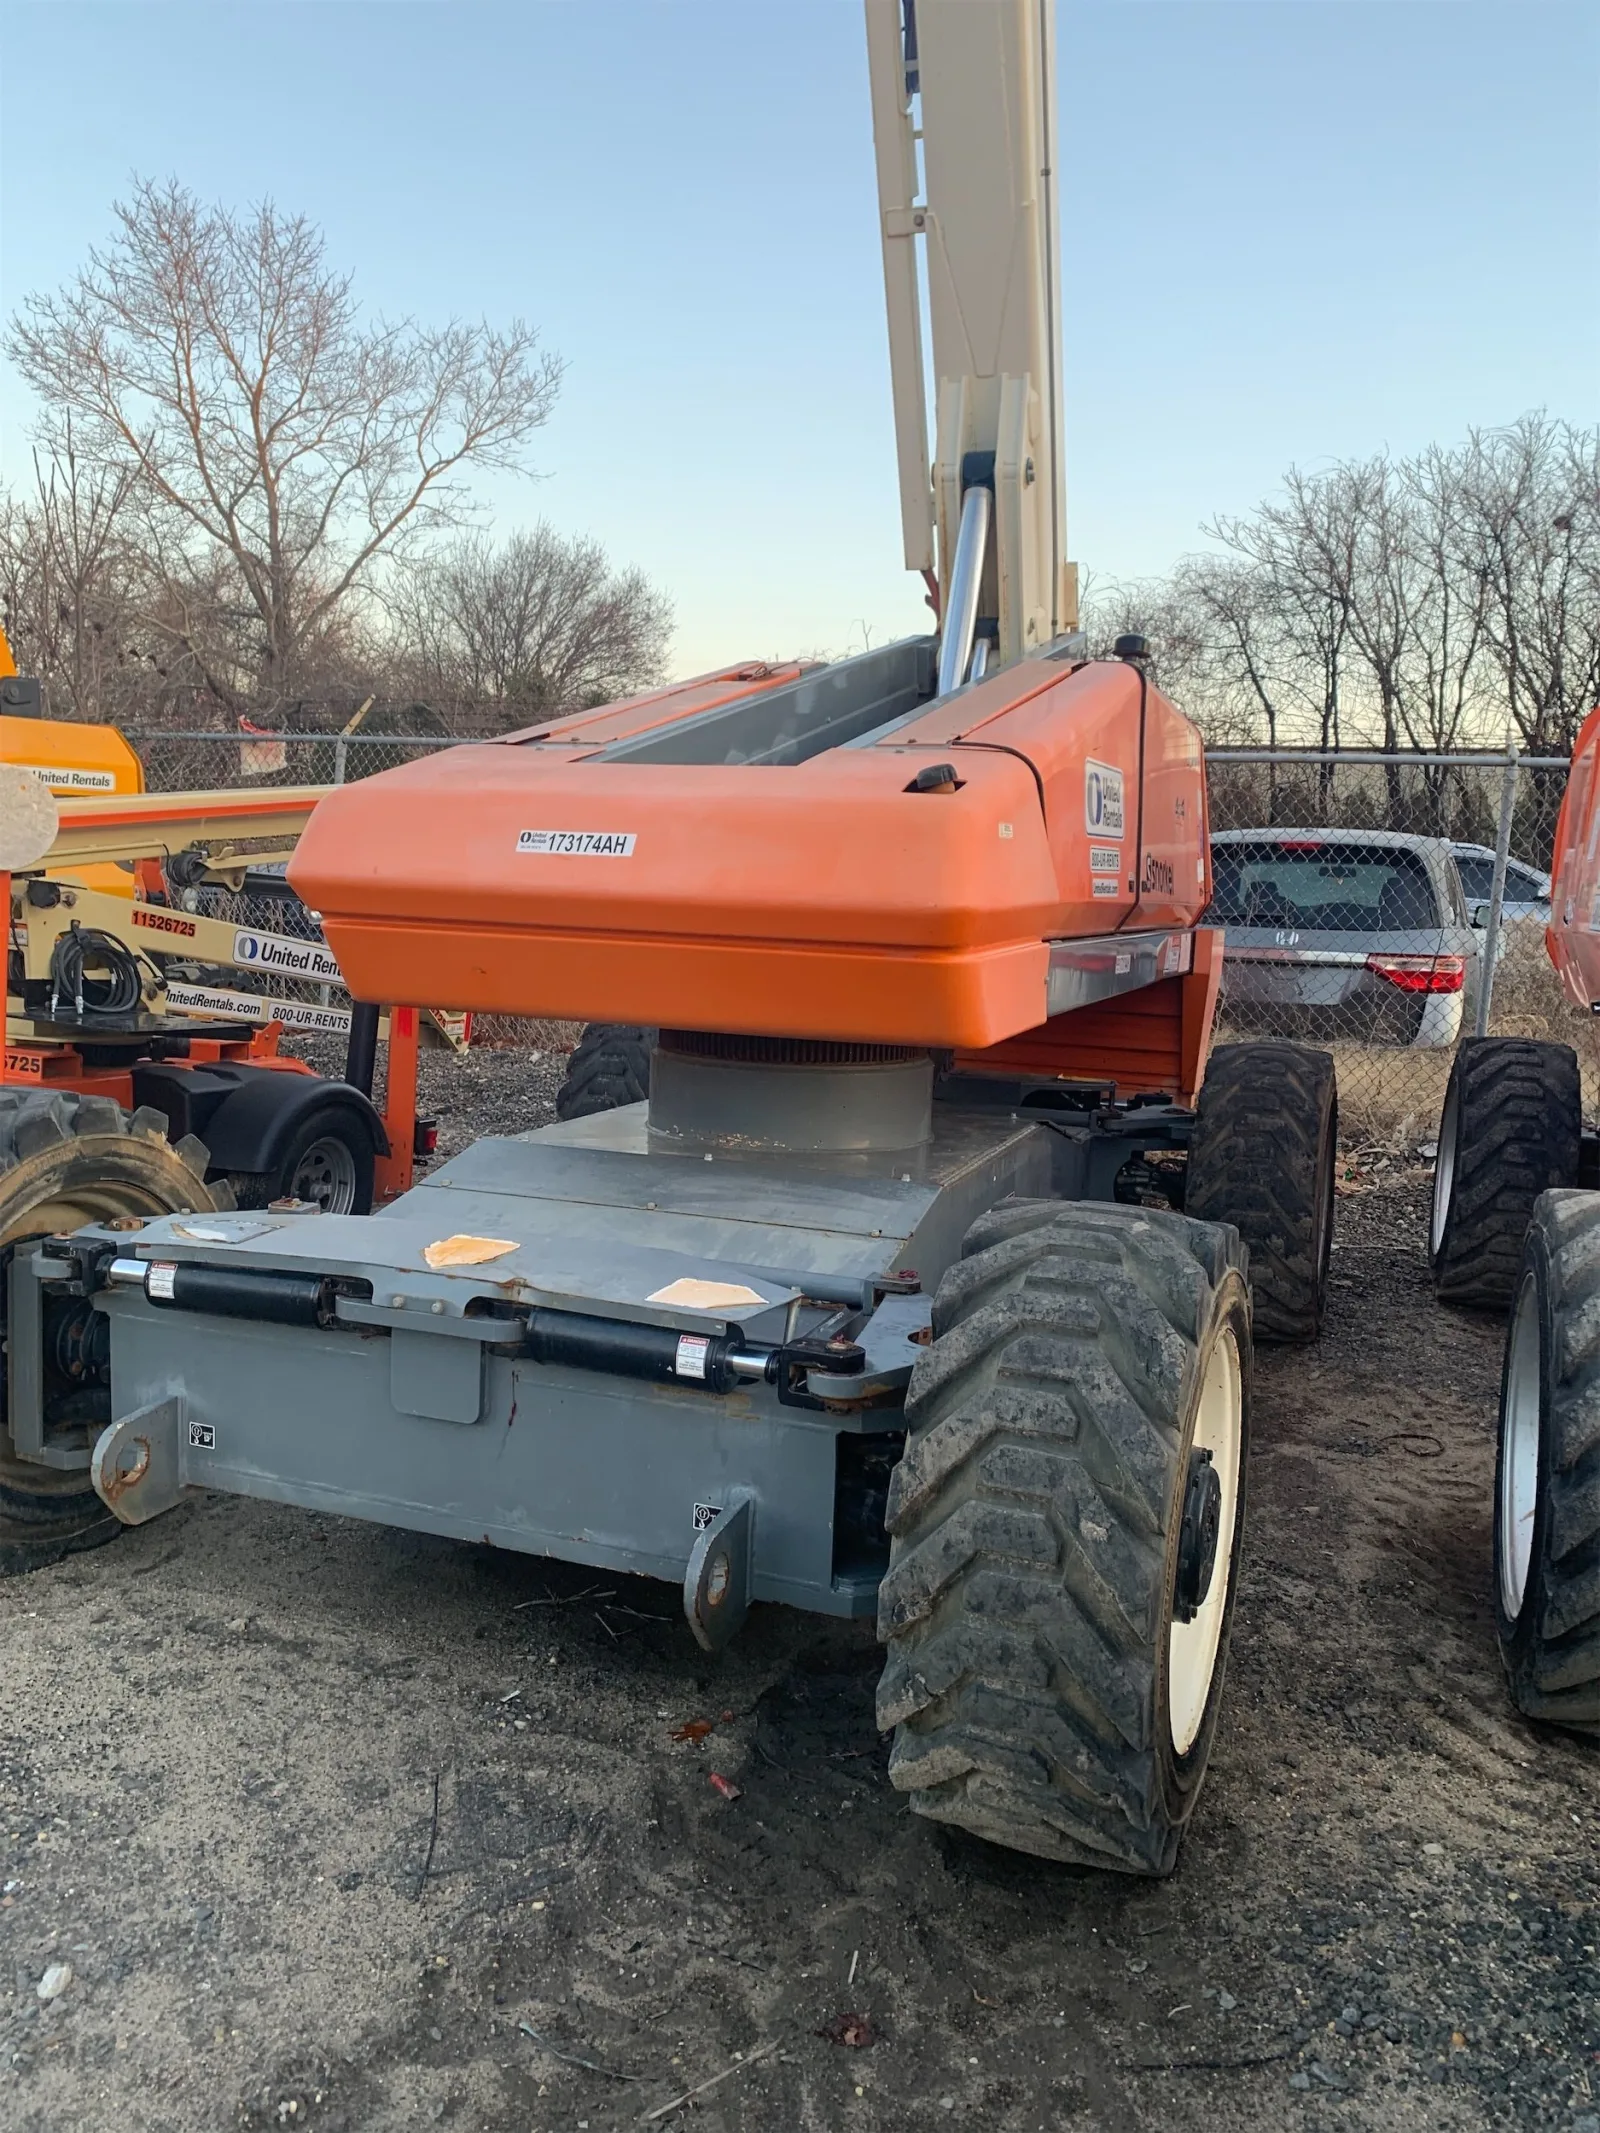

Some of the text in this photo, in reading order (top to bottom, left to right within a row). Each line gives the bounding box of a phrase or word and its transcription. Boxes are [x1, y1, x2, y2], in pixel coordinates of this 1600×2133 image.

[71, 773, 110, 787] Rentals
[549, 833, 627, 854] 173174AH
[132, 910, 196, 937] 11526725
[261, 942, 310, 969] United
[272, 1007, 350, 1030] 800-UR-RENTS
